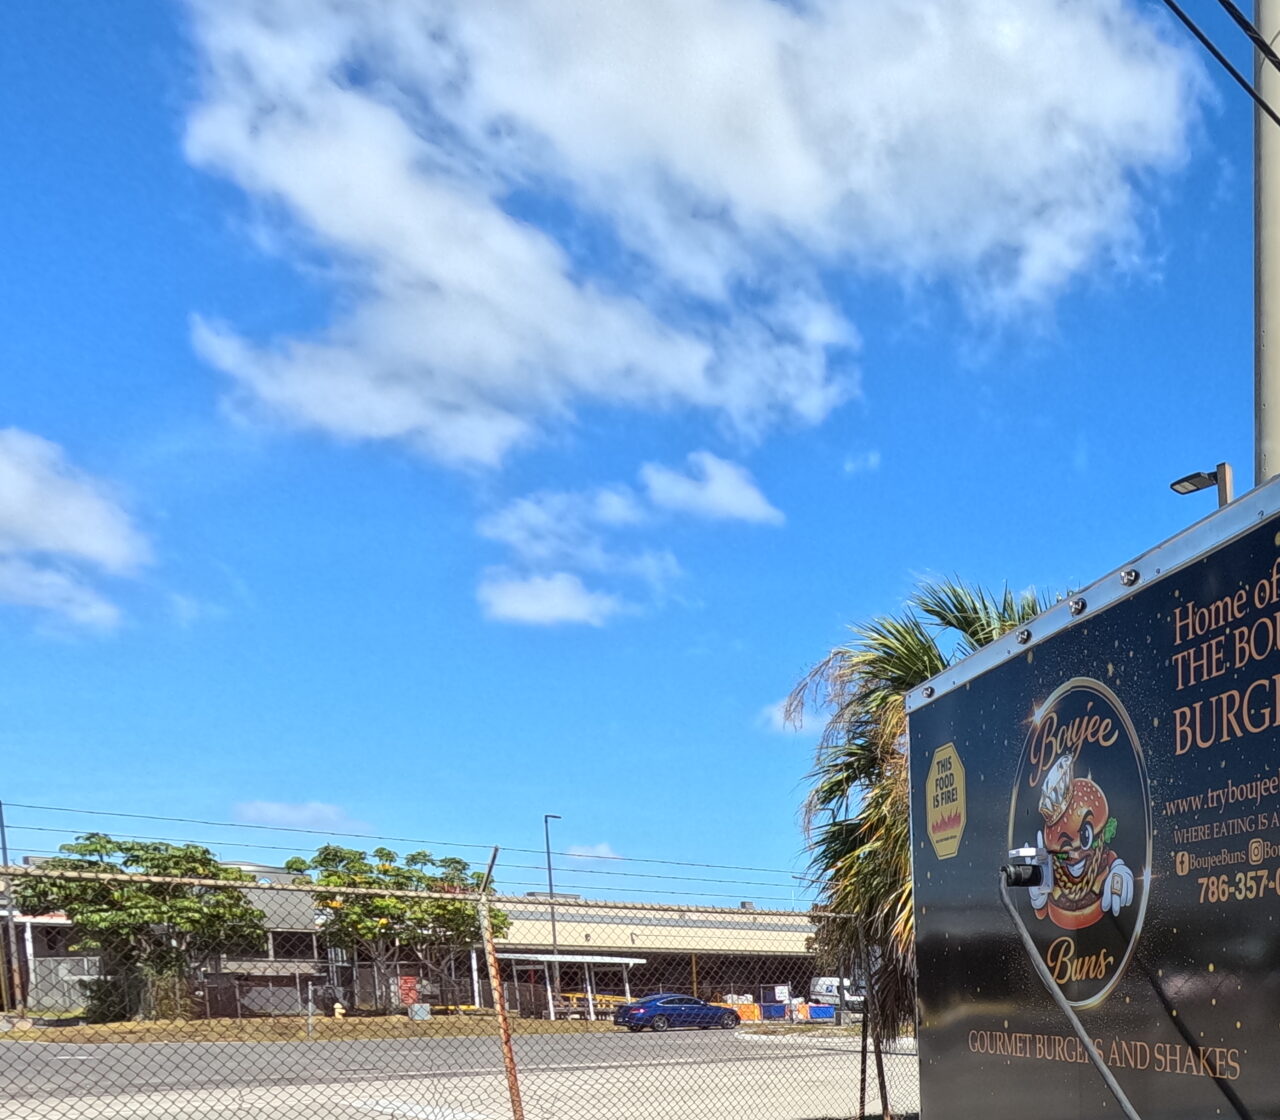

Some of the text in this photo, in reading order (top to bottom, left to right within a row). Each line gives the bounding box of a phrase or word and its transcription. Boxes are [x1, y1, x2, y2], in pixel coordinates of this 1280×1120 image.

[1174, 557, 1280, 645] Home of
[1172, 636, 1226, 691] THE
[1029, 701, 1119, 787] Boujee
[935, 773, 954, 792] FOOD
[936, 756, 952, 775] THIS
[933, 787, 958, 809] IS FIRE!
[1173, 824, 1212, 844] WHERE
[1214, 815, 1255, 839] EATING
[1258, 812, 1268, 831] IS
[1271, 811, 1279, 828] A
[1190, 849, 1246, 873] BoujeeBuns
[1047, 936, 1113, 985] Buns
[968, 1030, 1033, 1058] GOURMET
[1108, 1040, 1150, 1070] AND
[1154, 1042, 1240, 1080] SHAKES
